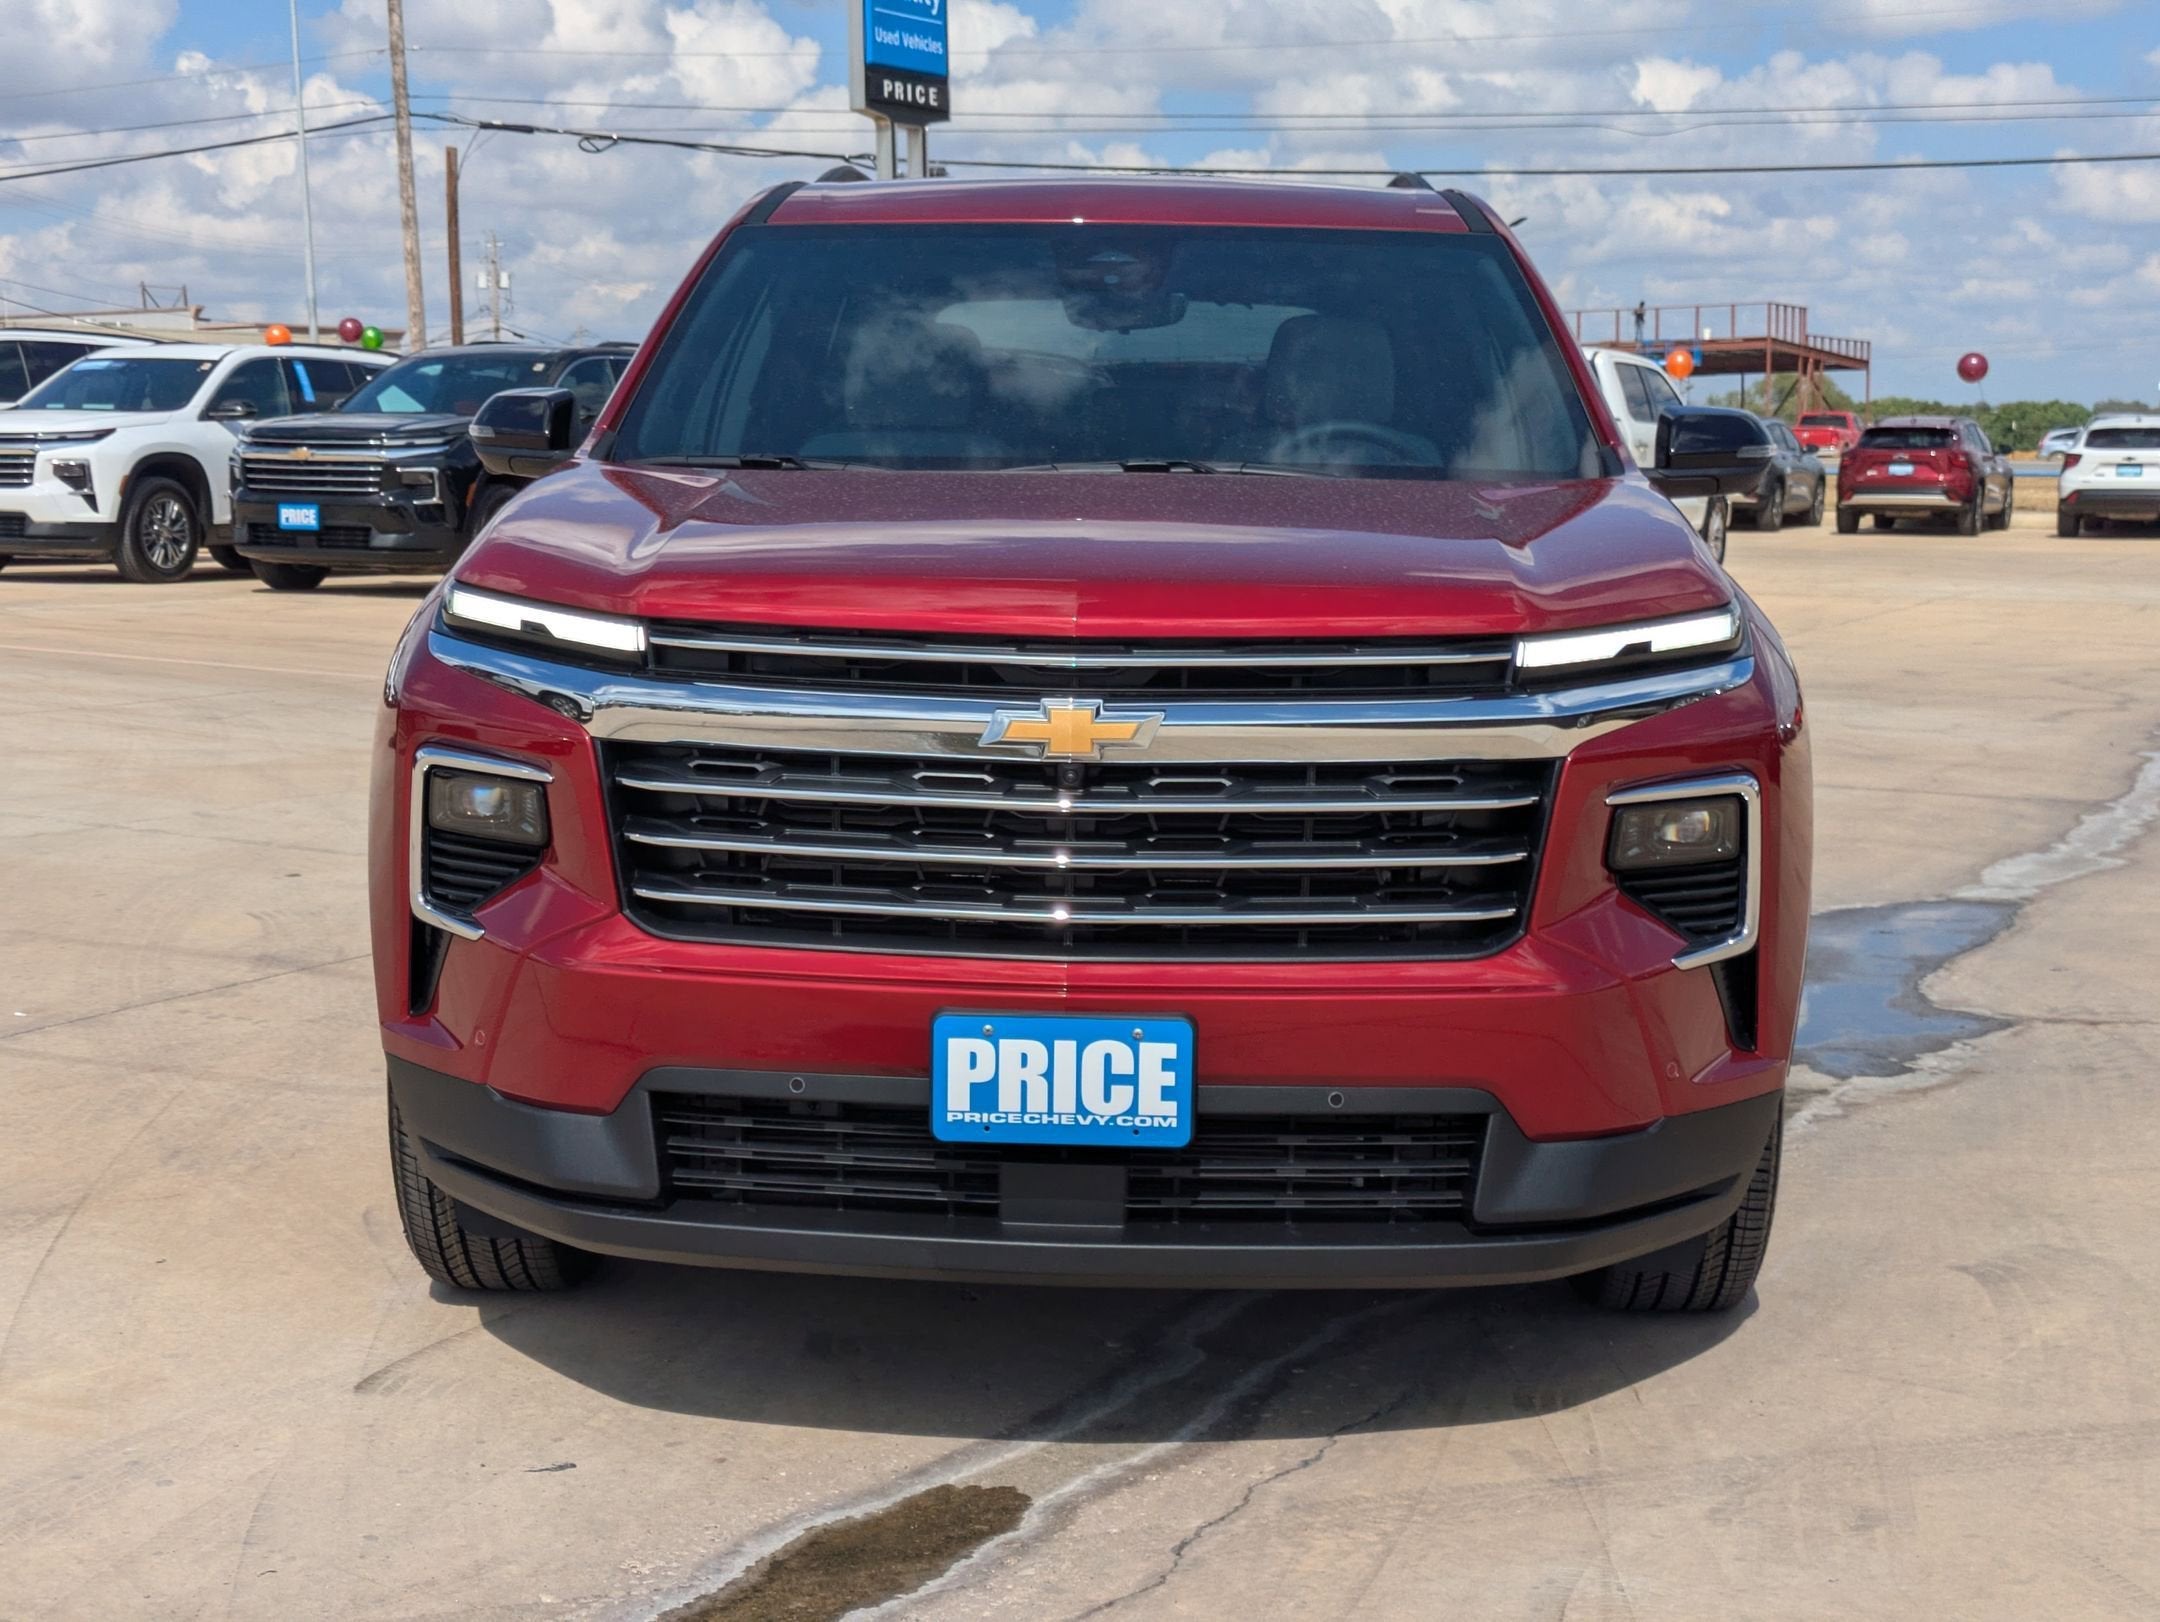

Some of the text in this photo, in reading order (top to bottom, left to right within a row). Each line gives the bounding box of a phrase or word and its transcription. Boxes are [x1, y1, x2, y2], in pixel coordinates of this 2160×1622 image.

[874, 26, 943, 55] Used Vehicles
[883, 79, 938, 106] PRICE
[281, 508, 317, 525] PRICE
[947, 1038, 1178, 1116] PRICE
[946, 1111, 1178, 1128] PRICECHEVY.COM
